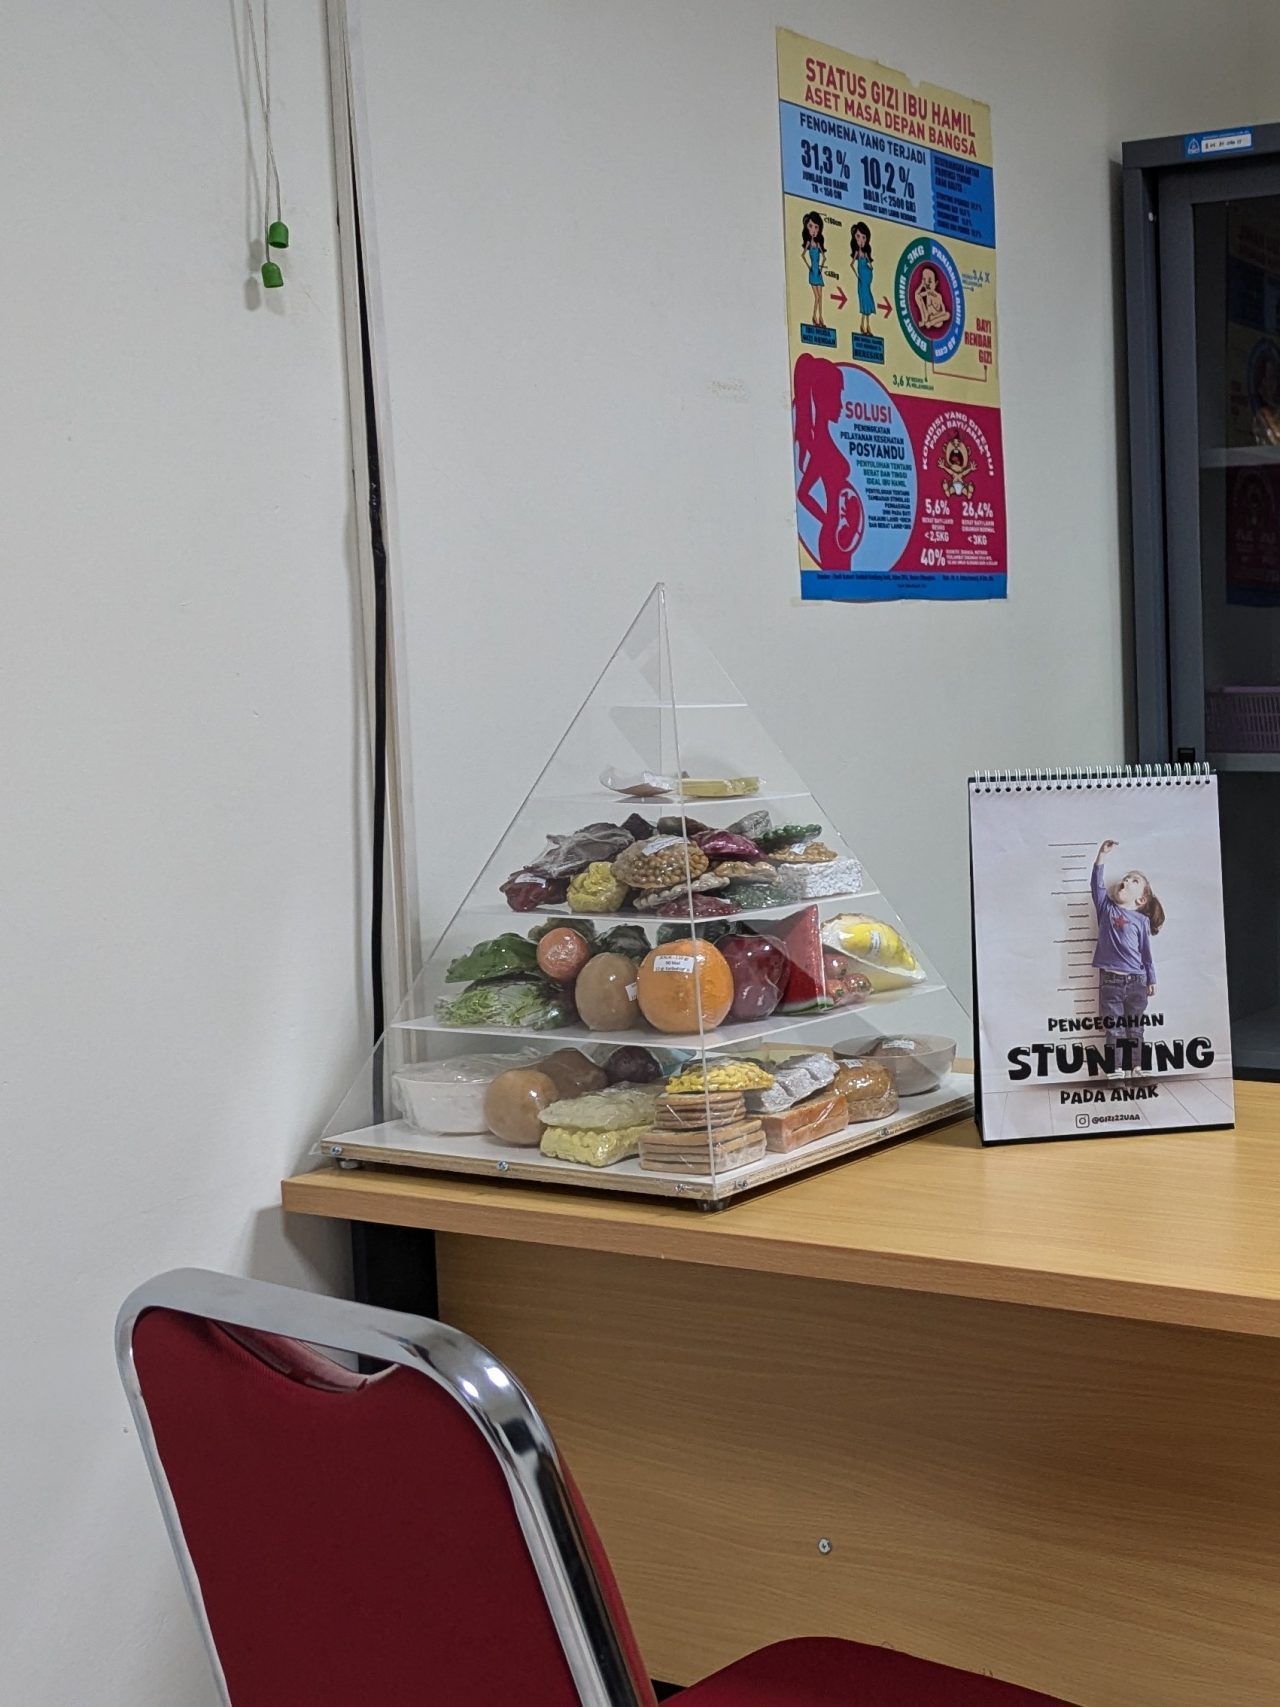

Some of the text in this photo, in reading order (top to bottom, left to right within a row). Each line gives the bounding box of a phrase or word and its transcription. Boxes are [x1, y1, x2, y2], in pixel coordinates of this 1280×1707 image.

[806, 57, 976, 138] STATUS GIZI IBU HAMIL
[805, 84, 977, 157] ASET MASA DEPAN BANGSA
[800, 112, 926, 166] FENOMENA YANG TERJADI
[801, 139, 850, 179] 31,3 %
[860, 155, 896, 194] 10,2
[900, 166, 915, 199] %
[976, 318, 991, 333] BAYI
[964, 331, 992, 349] RENDAH
[978, 350, 992, 365] GIZI
[845, 401, 892, 424] SOLUSI
[840, 431, 873, 442] PELAYANAN
[922, 415, 944, 470] KONDISI
[944, 411, 967, 421] YANG
[930, 426, 947, 449] PADA
[848, 441, 905, 460] POSYANDU
[925, 498, 950, 516] 5,6%
[962, 501, 994, 519] 26,4%
[920, 548, 946, 566] 40%
[1048, 1013, 1164, 1032] PENCEGAHAN
[1007, 1036, 1215, 1081] STUNTING
[1060, 1083, 1160, 1105] PADA ANAK
